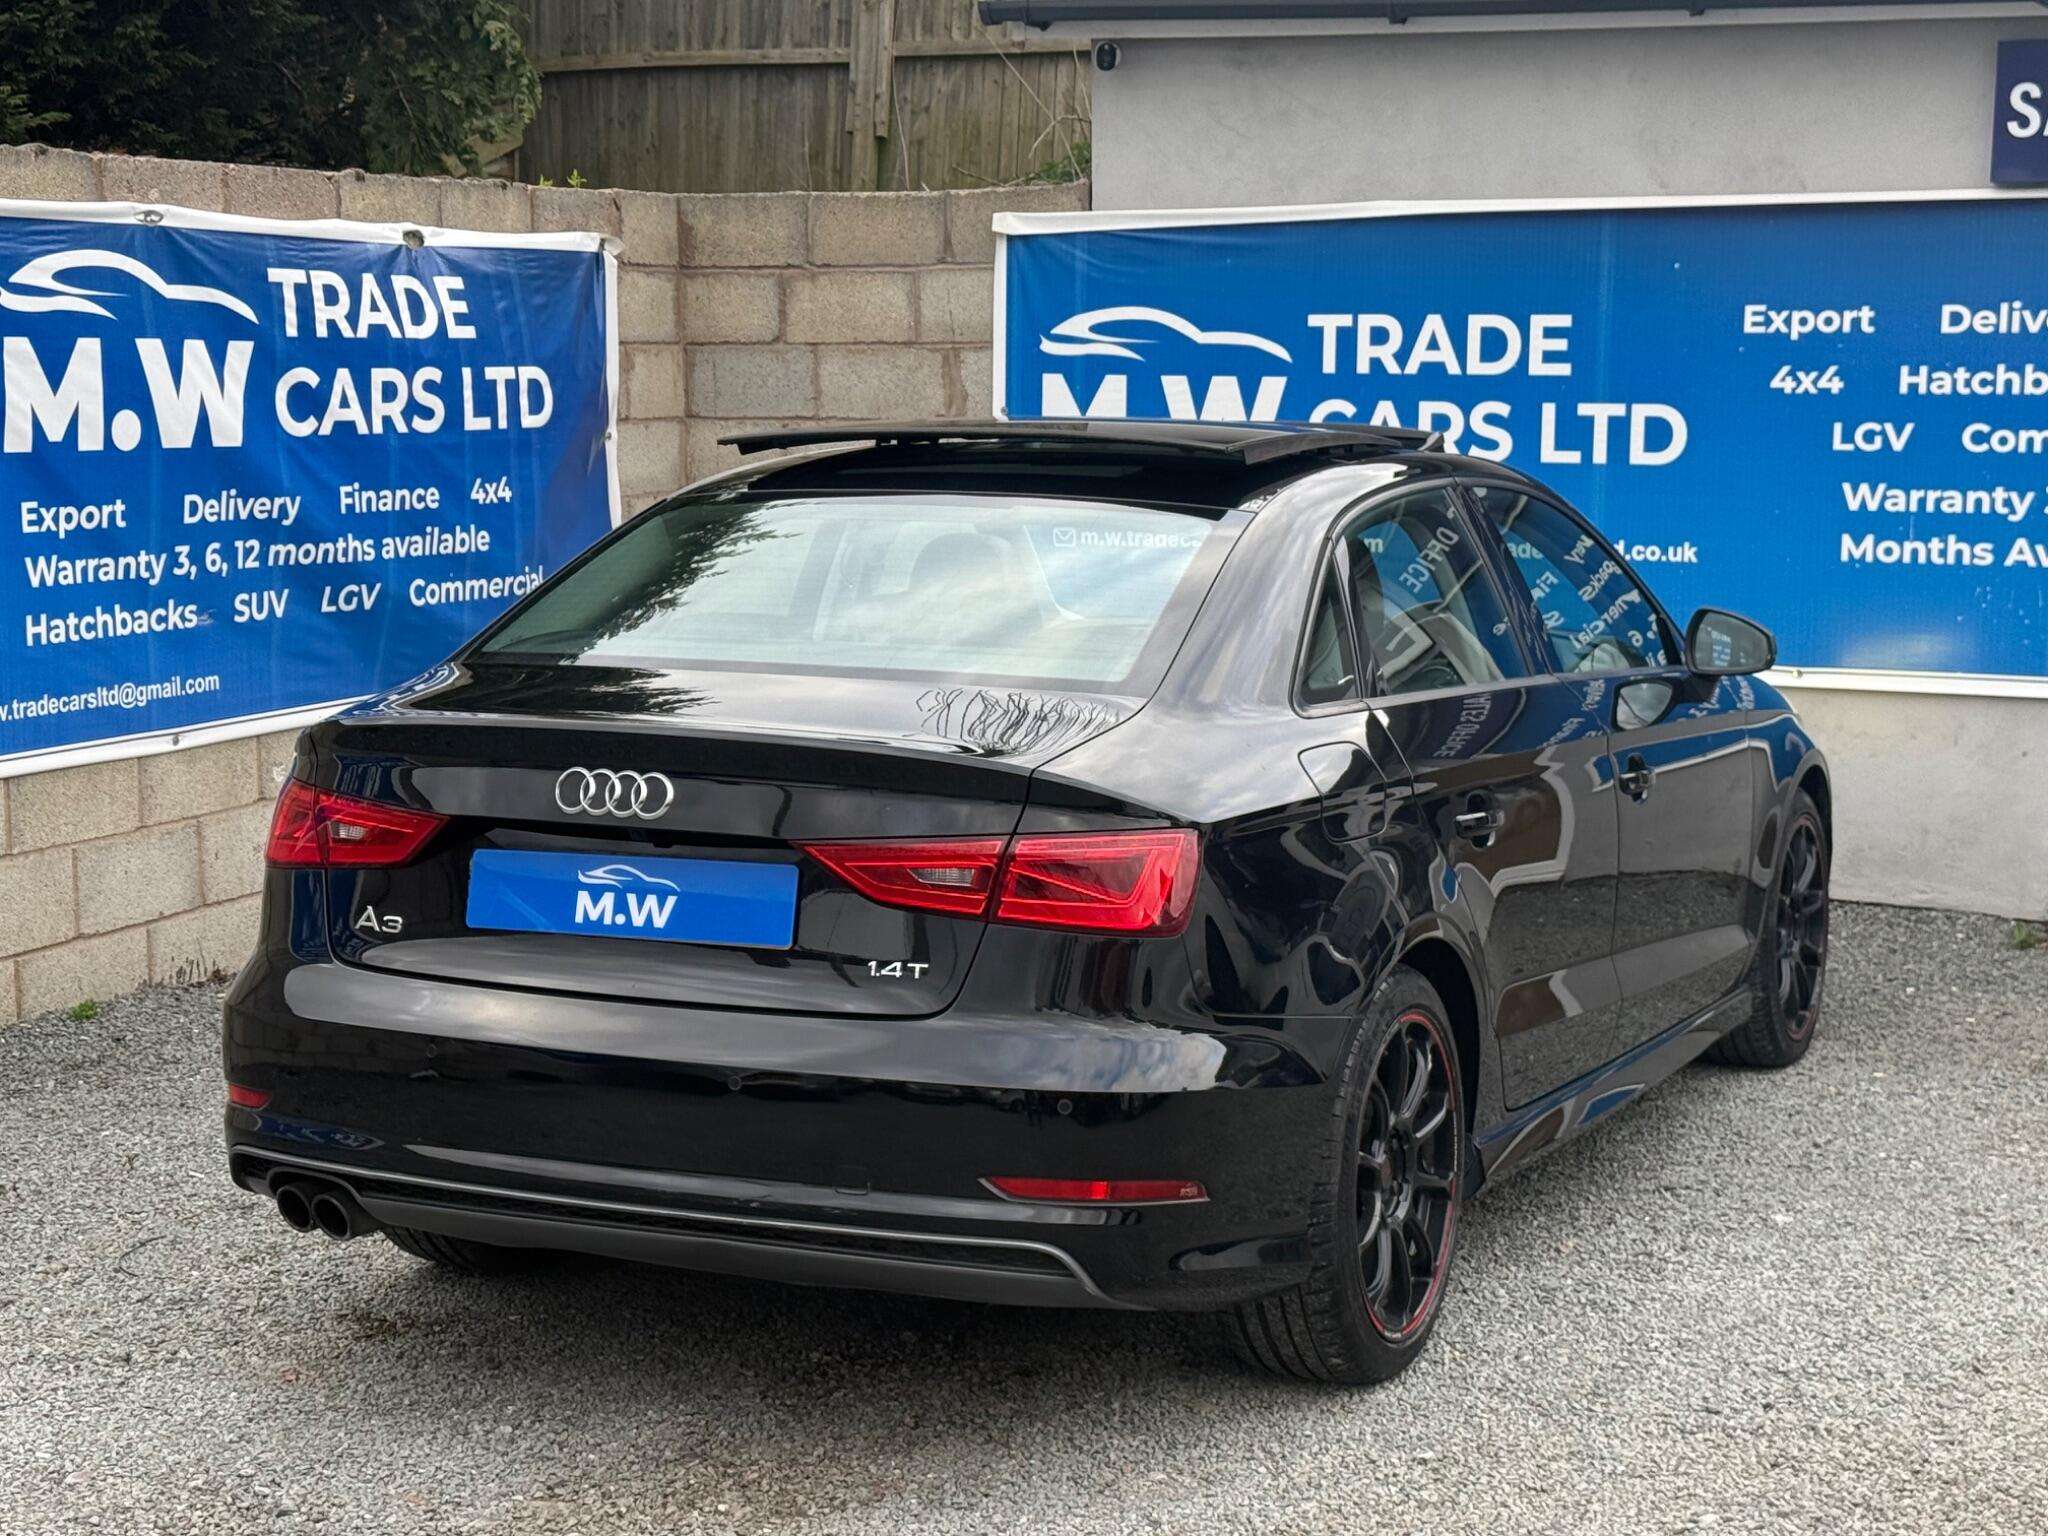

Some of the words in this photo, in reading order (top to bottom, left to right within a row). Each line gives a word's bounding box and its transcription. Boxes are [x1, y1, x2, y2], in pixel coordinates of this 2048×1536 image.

[2006, 82, 2048, 138] S
[267, 267, 477, 340] TRADE
[1743, 304, 1875, 341] Export
[1940, 300, 2048, 334] Deliv
[1307, 314, 1572, 377] TRADE
[3, 336, 255, 453] M.W
[275, 366, 446, 438] CARS
[462, 366, 554, 431] LTD
[1769, 365, 1845, 394] 4x4
[1540, 402, 1688, 466] LTD
[1832, 421, 1915, 452] LGV
[21, 499, 126, 539] Export
[183, 488, 301, 526] Delivery
[339, 482, 440, 514] Finance
[470, 476, 512, 504] 4x4
[1842, 482, 2035, 522] Warranty
[25, 550, 167, 588] Warranty
[173, 545, 198, 580] 3,
[205, 542, 228, 577] 6,
[235, 539, 260, 570] 12
[267, 533, 376, 567] months
[381, 524, 490, 560] available
[1840, 533, 1995, 566] Months
[26, 599, 198, 647] Hatchbacks
[234, 589, 289, 623] SUV
[321, 582, 382, 613] LGV
[409, 565, 543, 607] Commercial
[354, 905, 403, 933] A3
[575, 890, 678, 929] M.W
